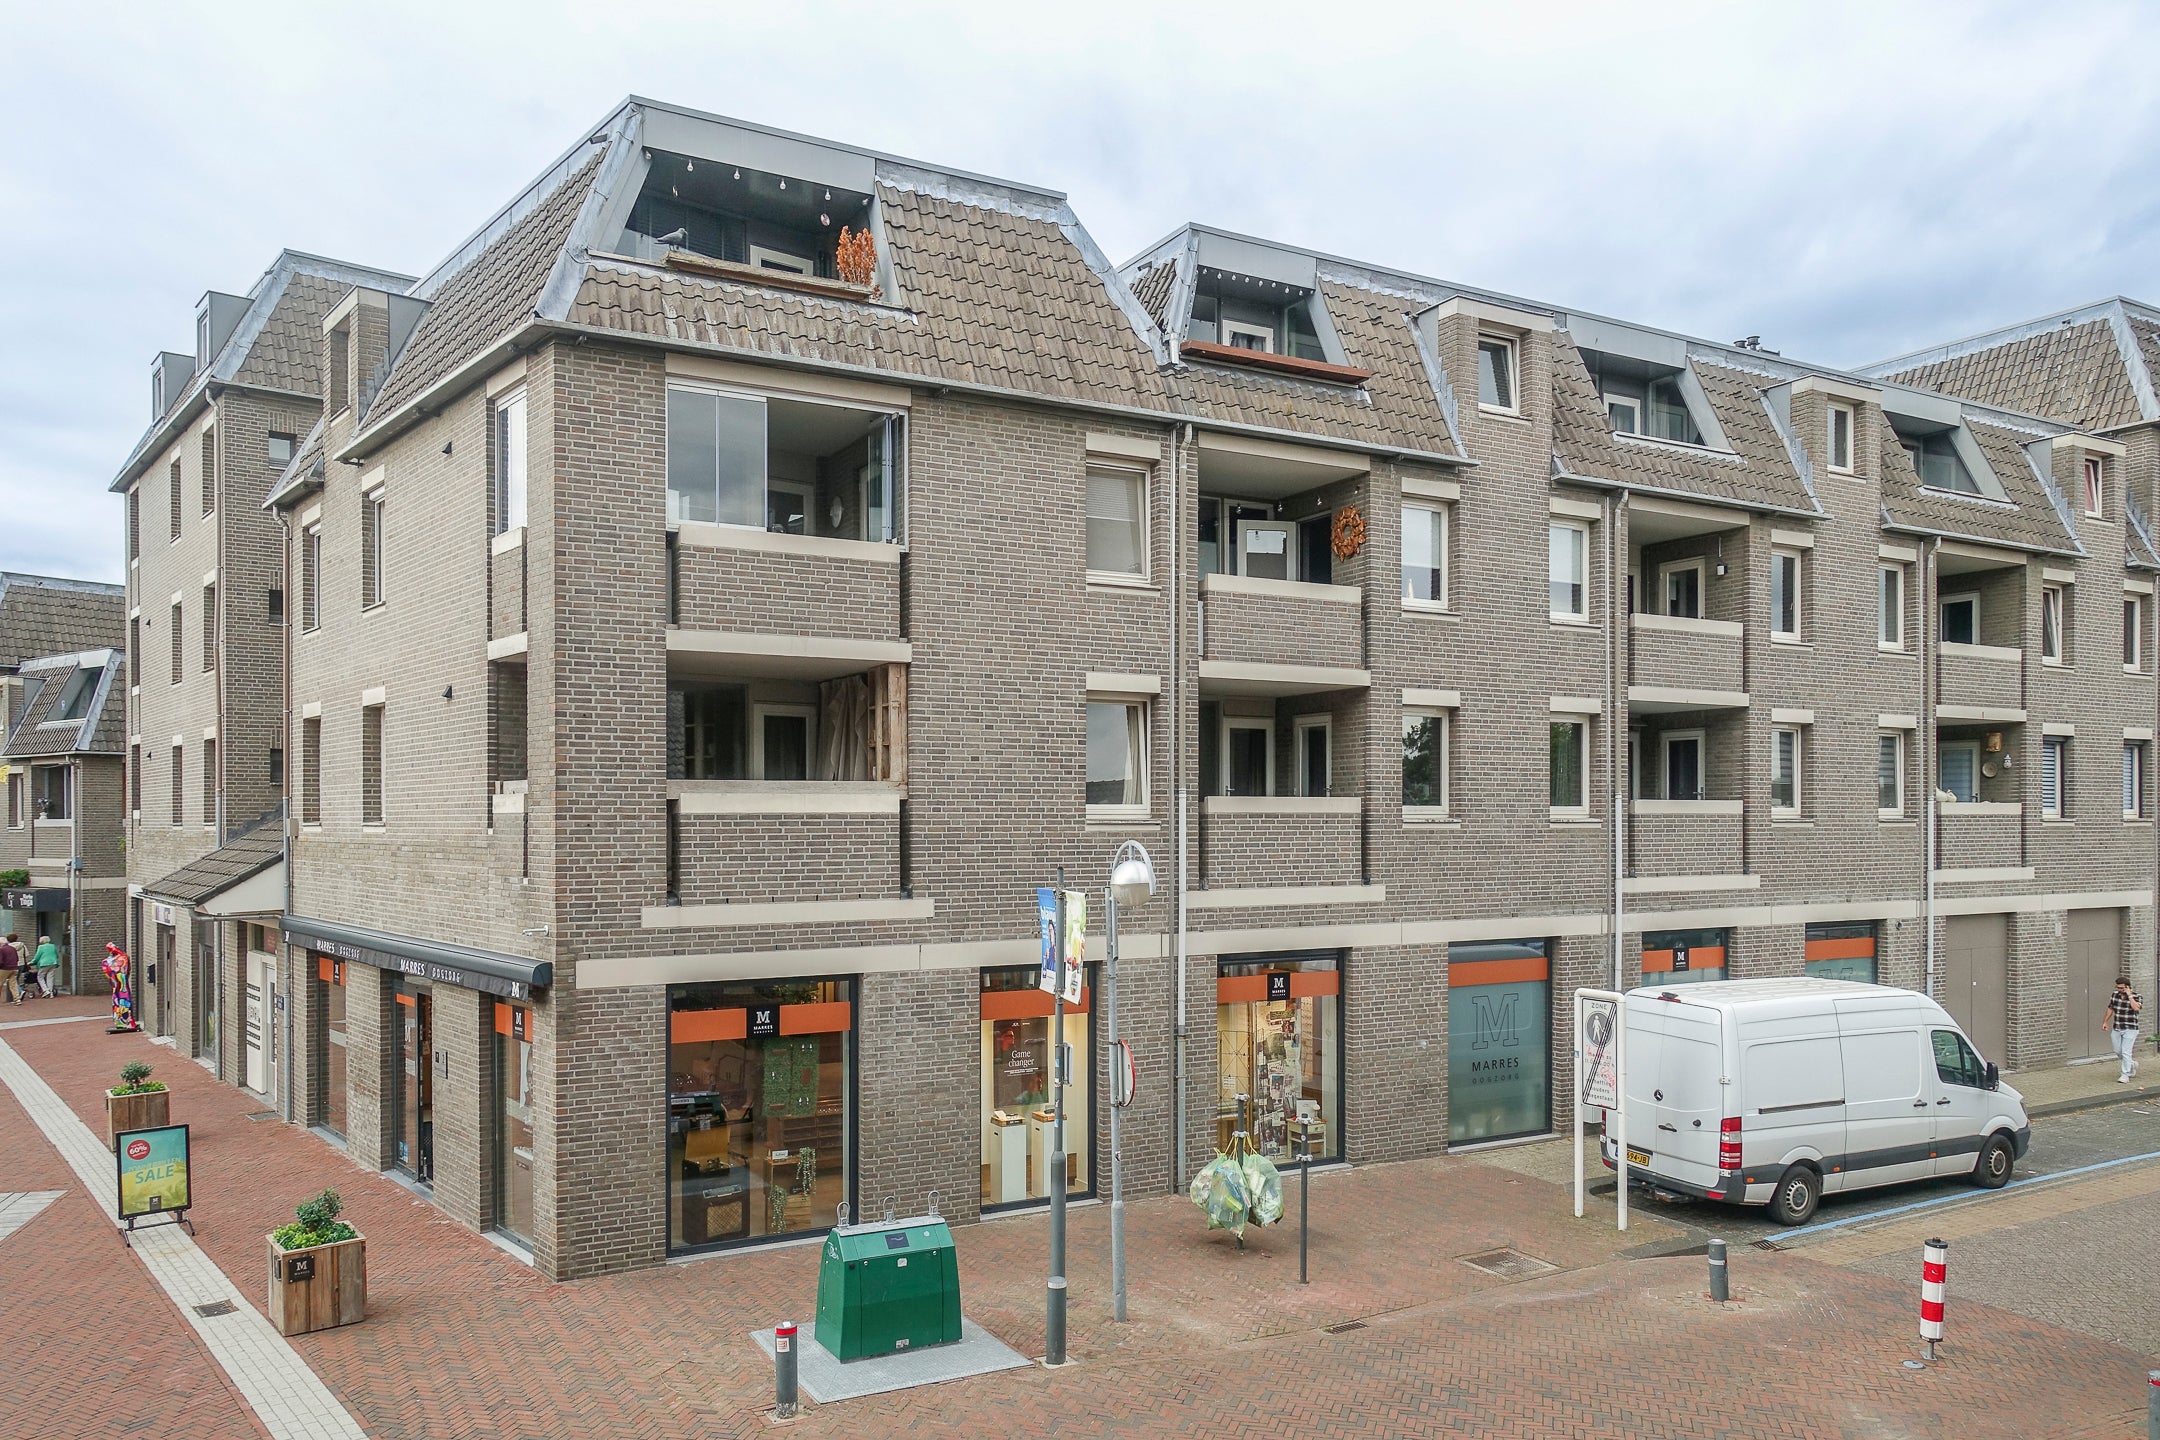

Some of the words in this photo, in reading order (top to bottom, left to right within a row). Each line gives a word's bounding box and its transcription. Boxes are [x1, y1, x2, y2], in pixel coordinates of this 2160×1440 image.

[316, 939, 335, 954] MARRES
[400, 959, 425, 976] MARRES
[1274, 977, 1284, 988] M
[511, 981, 520, 998] M
[1591, 1002, 1608, 1010] ZONE
[515, 1011, 522, 1025] M
[756, 1010, 770, 1023] M
[1471, 992, 1519, 1051] M
[1011, 1050, 1031, 1059] Game
[1008, 1058, 1035, 1068] changer
[1472, 1057, 1519, 1072] MARRES
[129, 1144, 148, 1155] 60%
[135, 1164, 175, 1185] SALE
[296, 1260, 308, 1271] M
